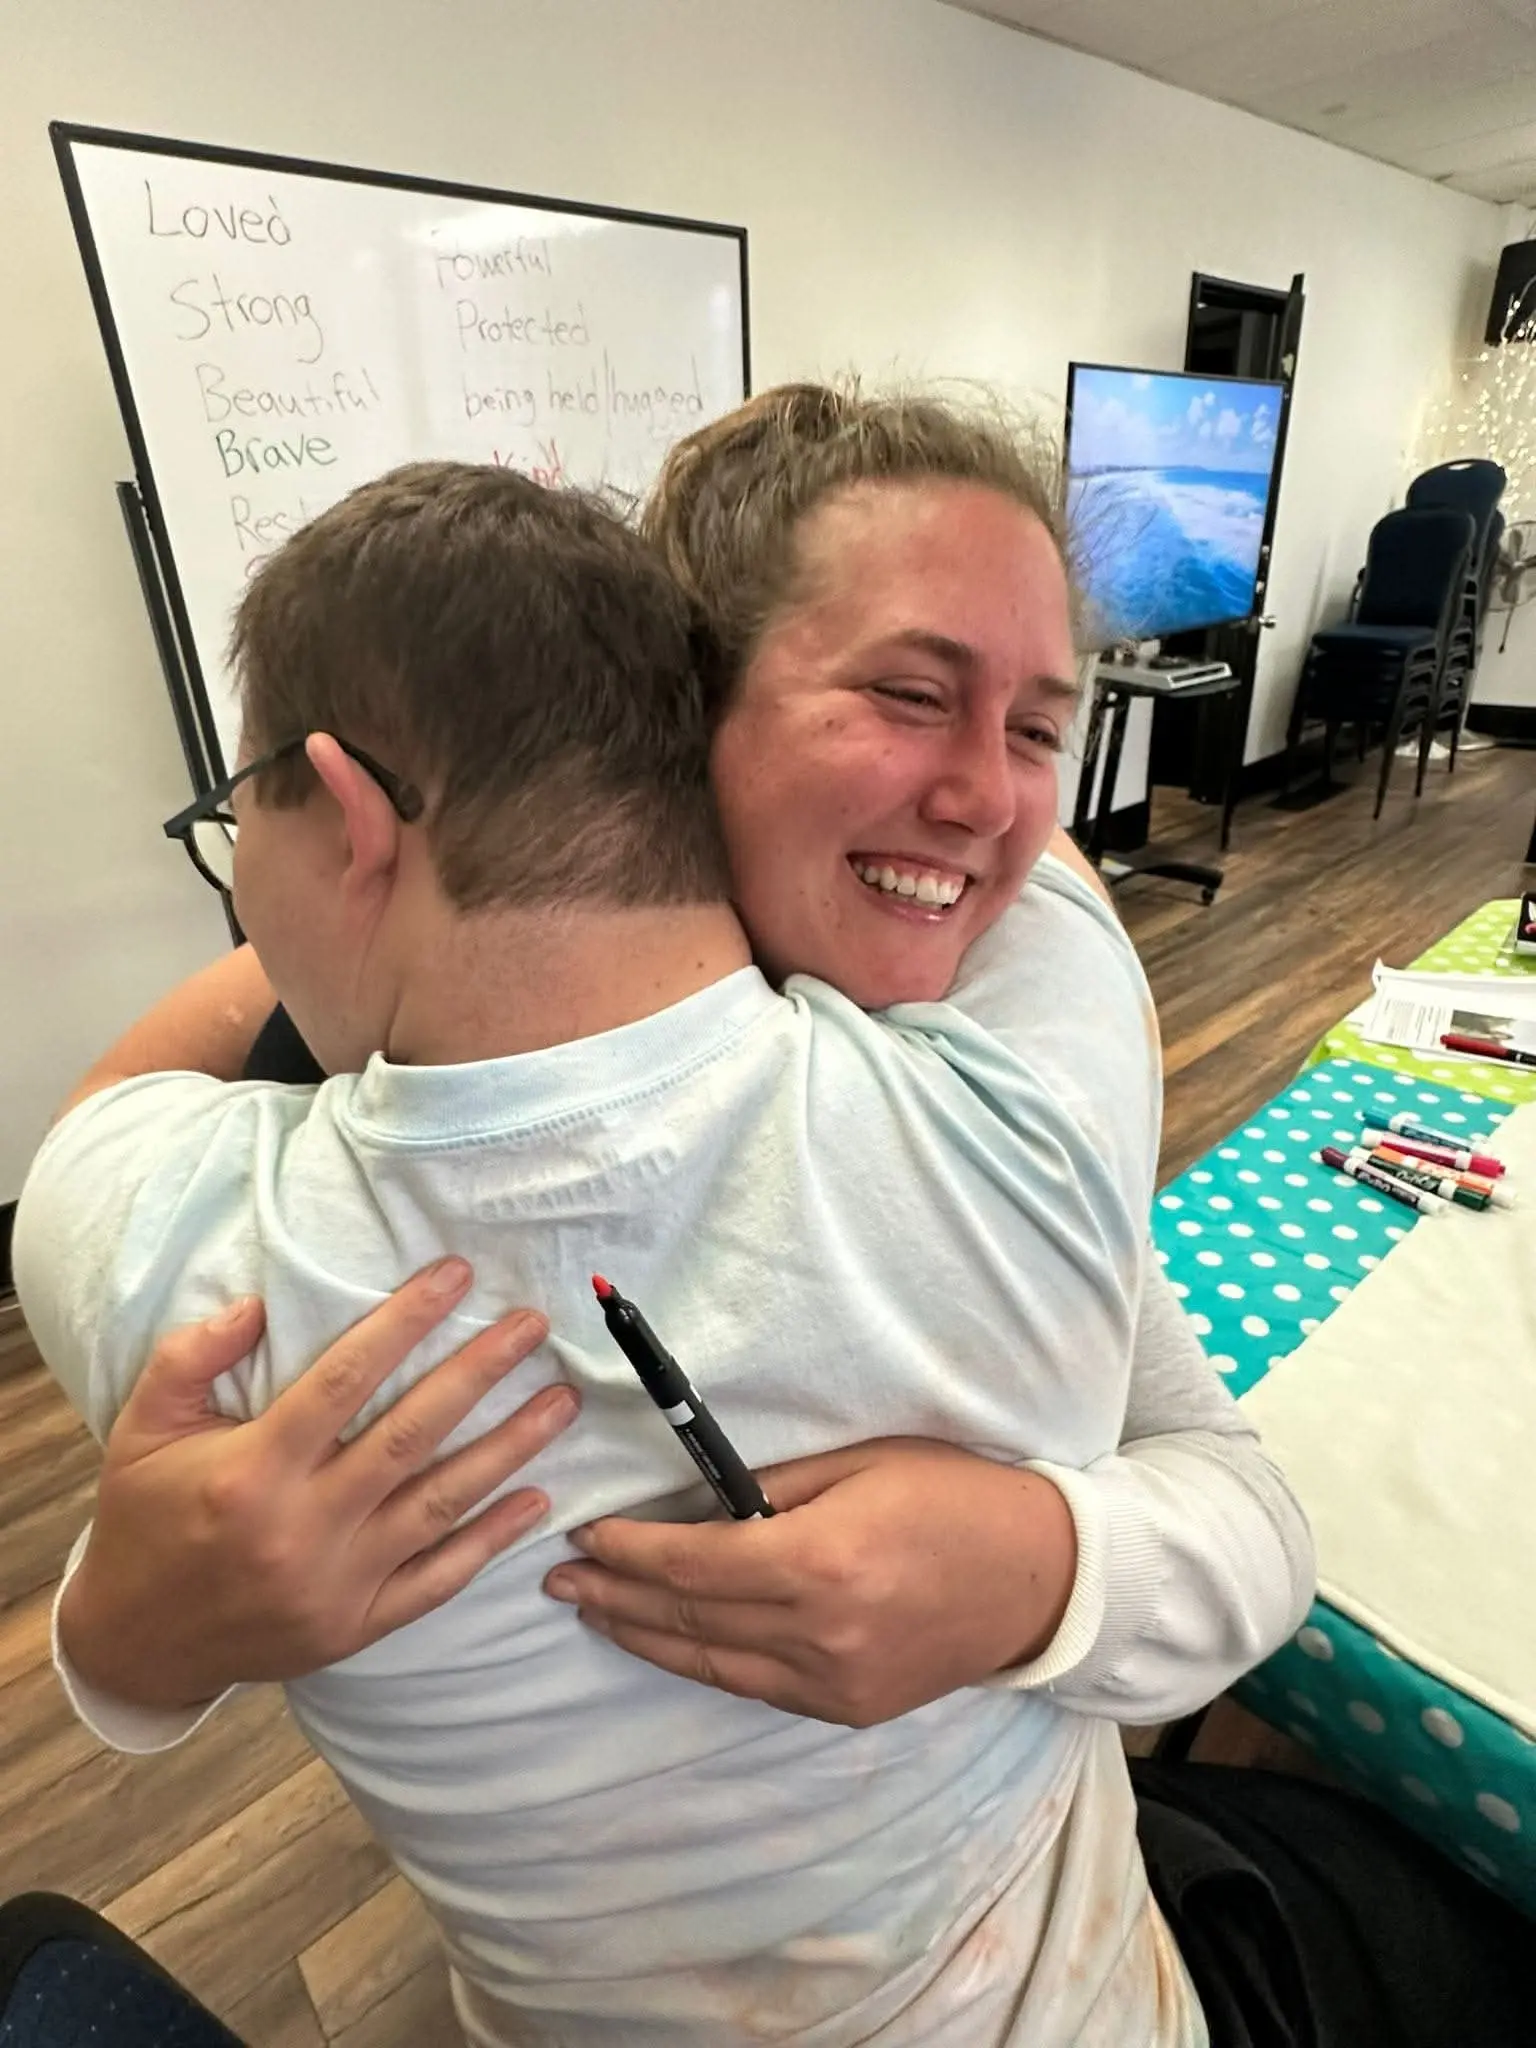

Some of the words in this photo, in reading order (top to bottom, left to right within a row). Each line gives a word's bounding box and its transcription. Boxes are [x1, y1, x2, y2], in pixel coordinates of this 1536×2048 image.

[144, 178, 292, 246] Loved
[169, 273, 325, 364] Strong
[456, 299, 591, 351] Protected
[195, 362, 381, 423] Beautiful
[462, 371, 538, 428] being
[216, 429, 338, 477] Brave
